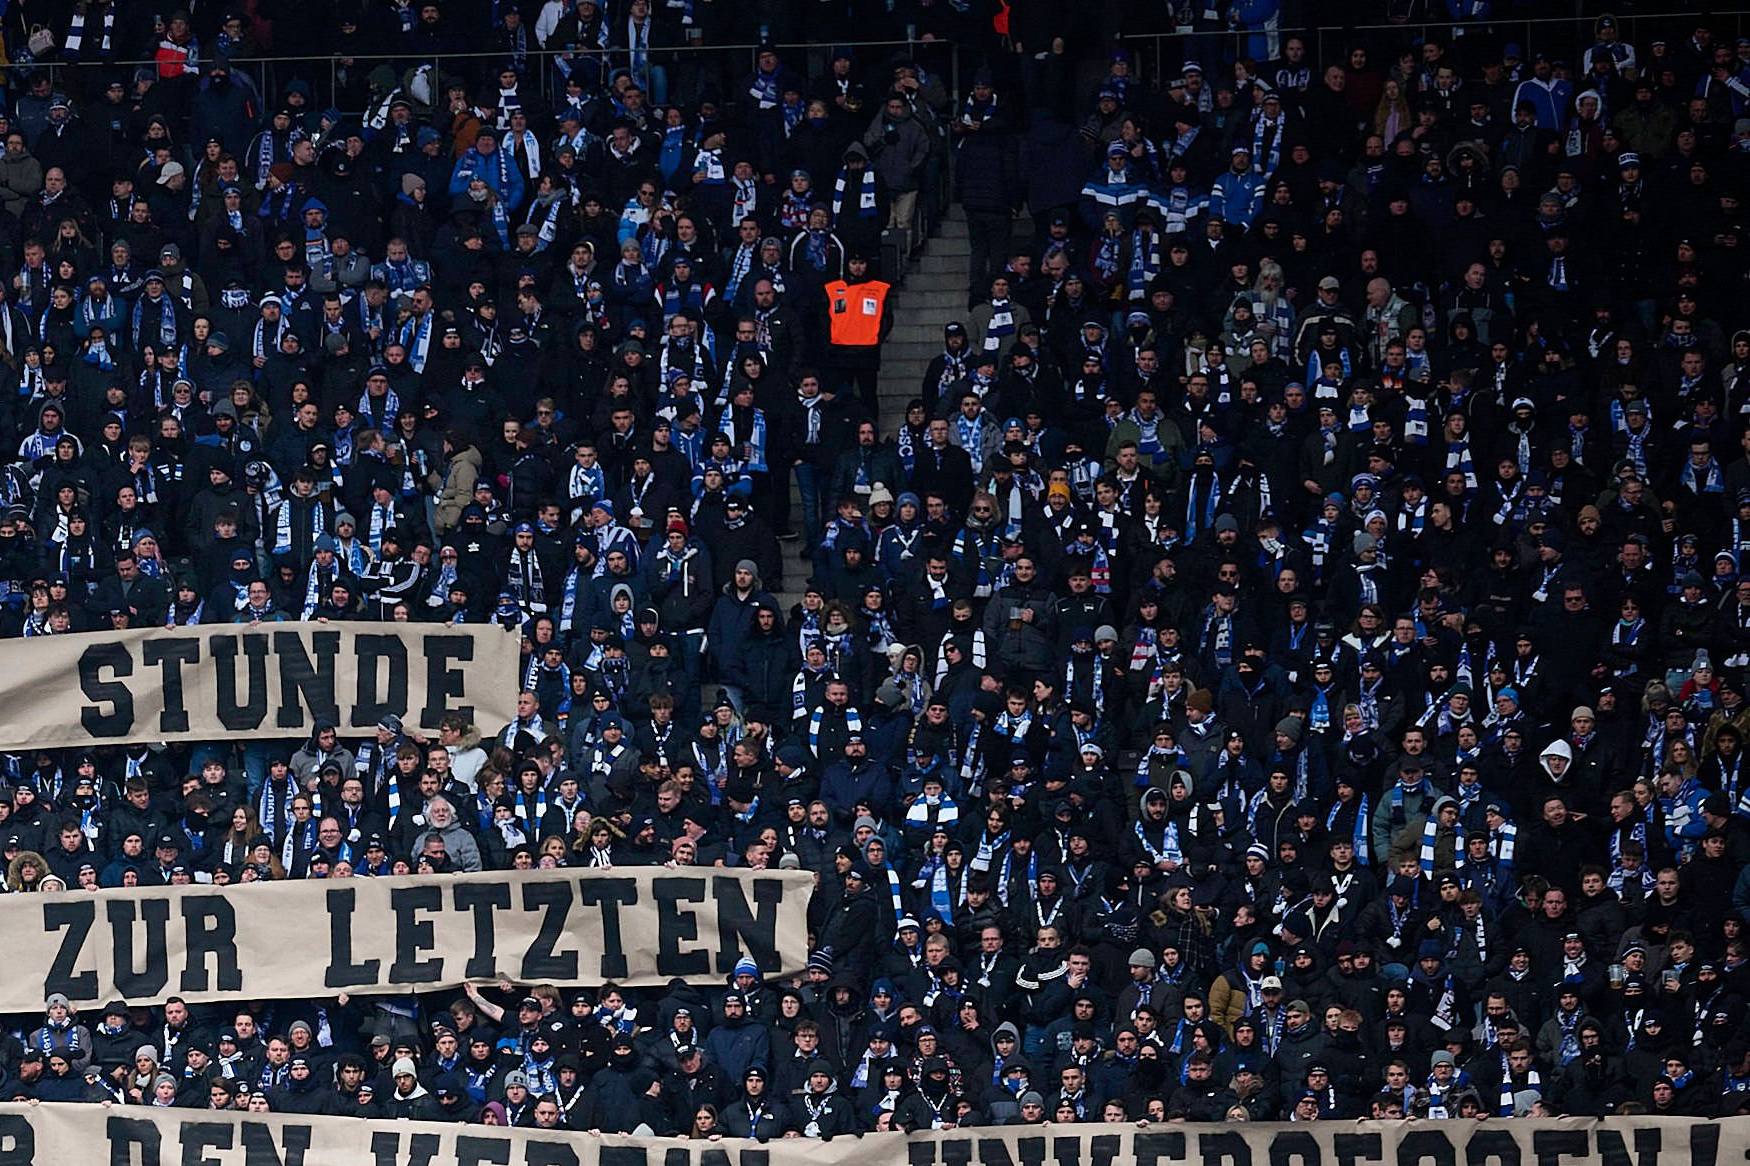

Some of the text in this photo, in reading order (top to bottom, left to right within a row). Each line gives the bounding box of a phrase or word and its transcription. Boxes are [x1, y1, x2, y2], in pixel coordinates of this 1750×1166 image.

[79, 631, 474, 738] STUNDE
[44, 894, 242, 1000] ZUR
[325, 877, 784, 988] LETZTEN
